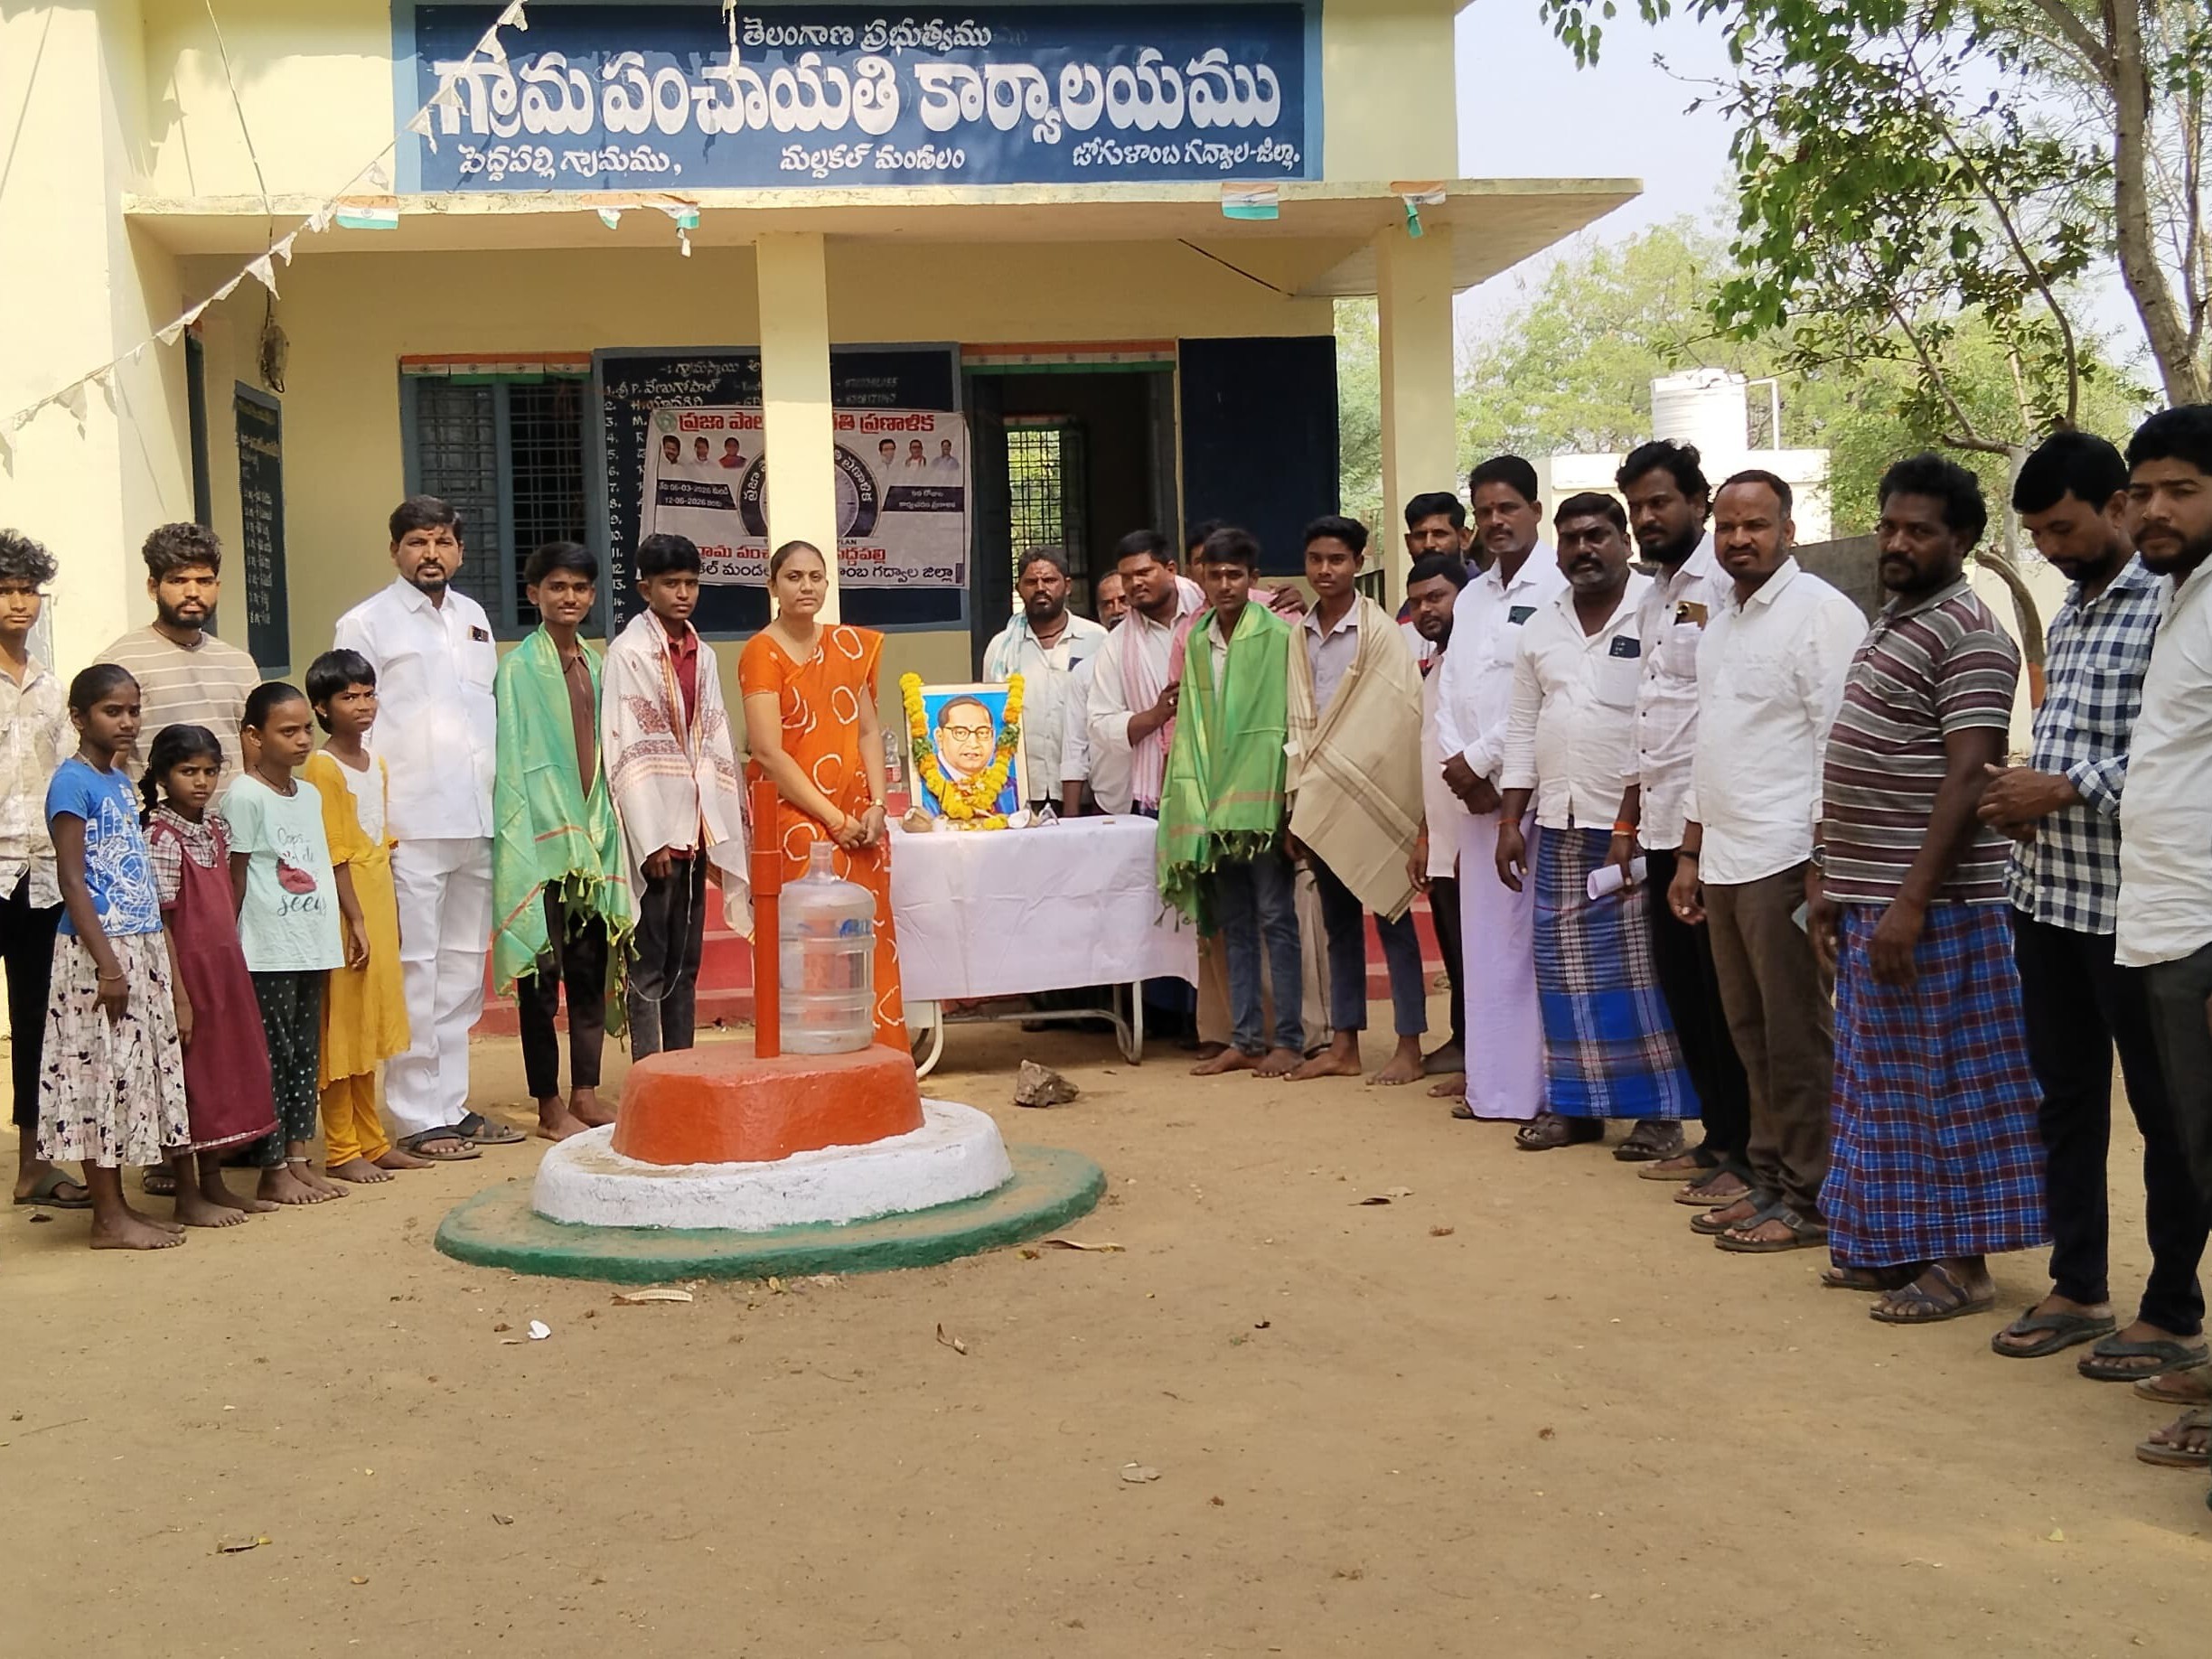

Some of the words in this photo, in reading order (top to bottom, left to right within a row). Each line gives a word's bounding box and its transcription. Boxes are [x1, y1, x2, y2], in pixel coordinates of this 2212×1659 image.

[743, 17, 854, 46] తెలంగాణ
[860, 18, 992, 52] ప్రభుత్వము
[914, 46, 1282, 145] కార్యాలయము
[457, 143, 557, 181] పెద్దపల్లి
[875, 144, 966, 170] మండలం
[1073, 136, 1181, 165] జోగుళాంబ
[679, 411, 725, 432] ప్రజా
[859, 412, 935, 434] ప్రణాళిక
[872, 565, 919, 582] గద్వాల
[923, 566, 953, 582] జిల్లా
